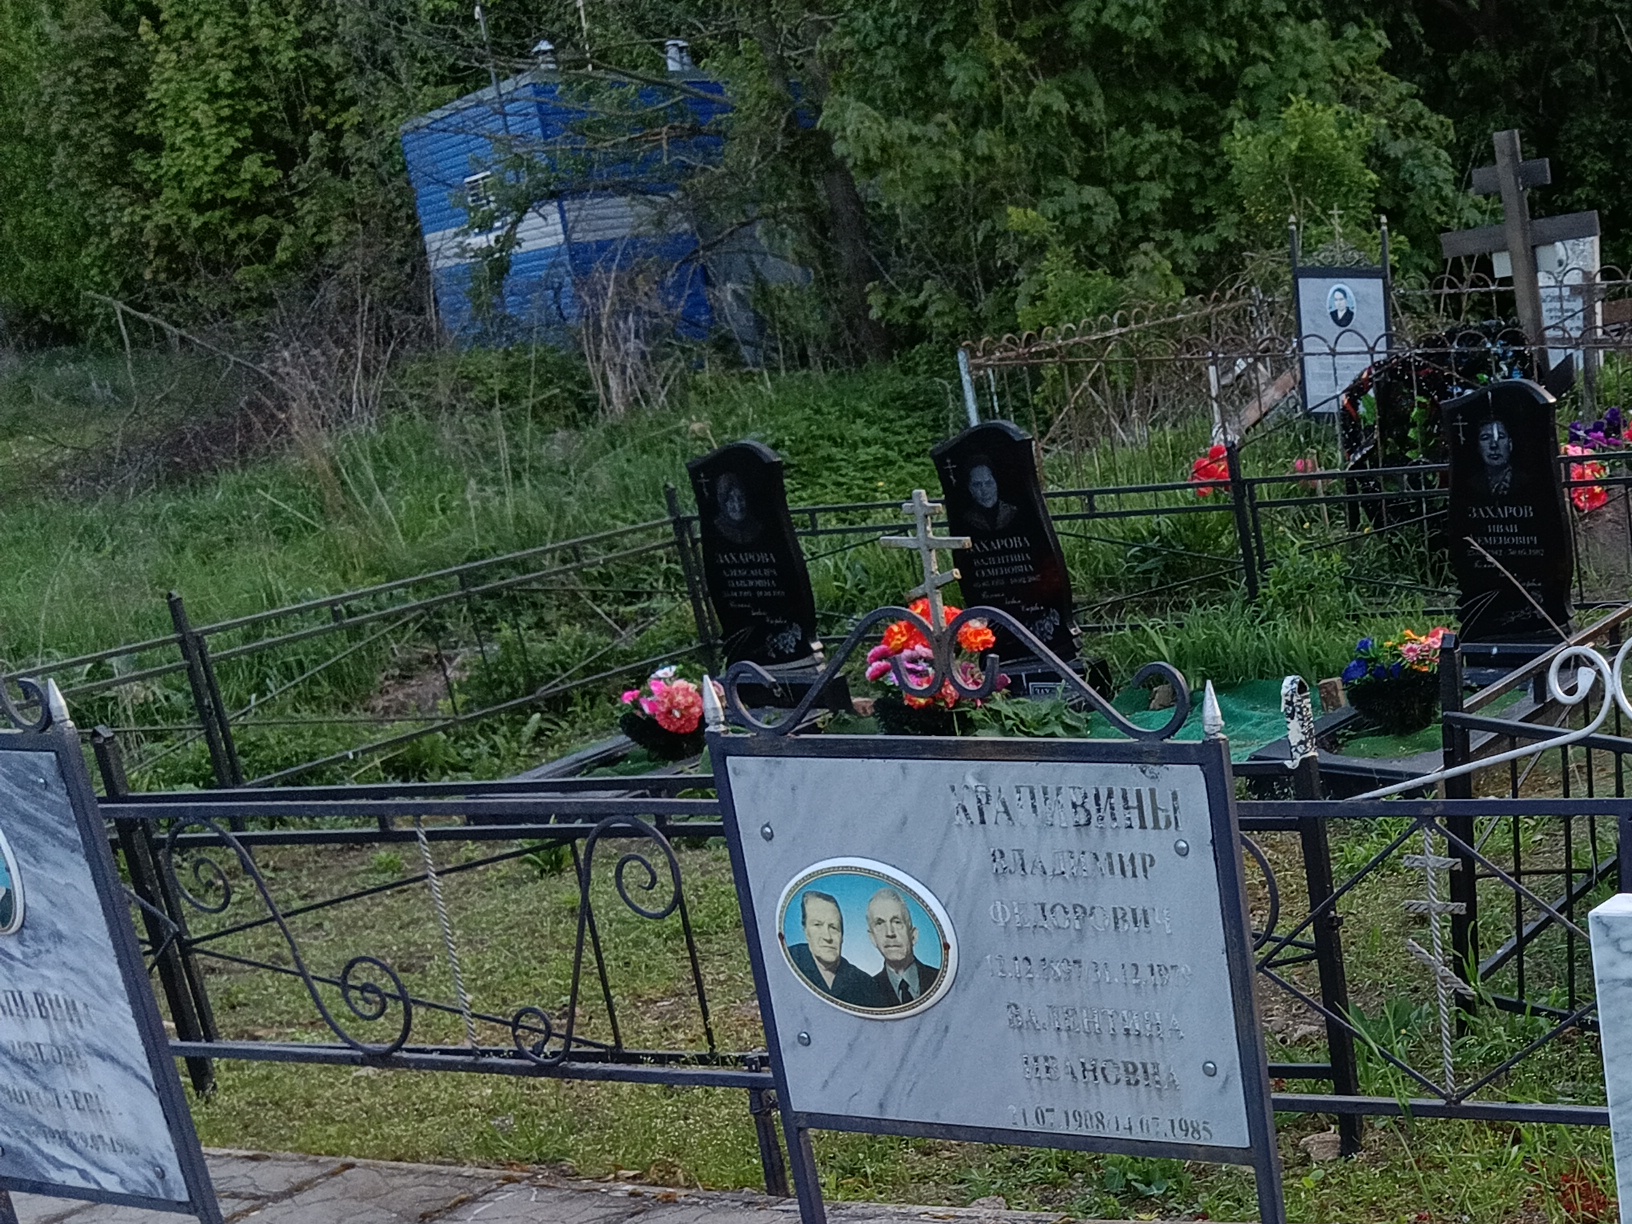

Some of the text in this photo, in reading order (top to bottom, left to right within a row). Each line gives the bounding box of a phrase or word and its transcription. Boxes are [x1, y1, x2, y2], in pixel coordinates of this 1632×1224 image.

[1467, 505, 1534, 518] ЗАХАРОВ
[966, 536, 1031, 552] АХАРОВА
[1471, 536, 1538, 545] ЕМЕНОВИЧ
[950, 785, 1184, 831] КРАПИВИНЫ
[990, 848, 1156, 880] ВЛАДИМИР
[989, 901, 1173, 935] ФЕДОРОВИЧ
[1006, 1003, 1185, 1039] ВАЛЕНТИНА
[1022, 1053, 1181, 1090] ИВАНОВНА
